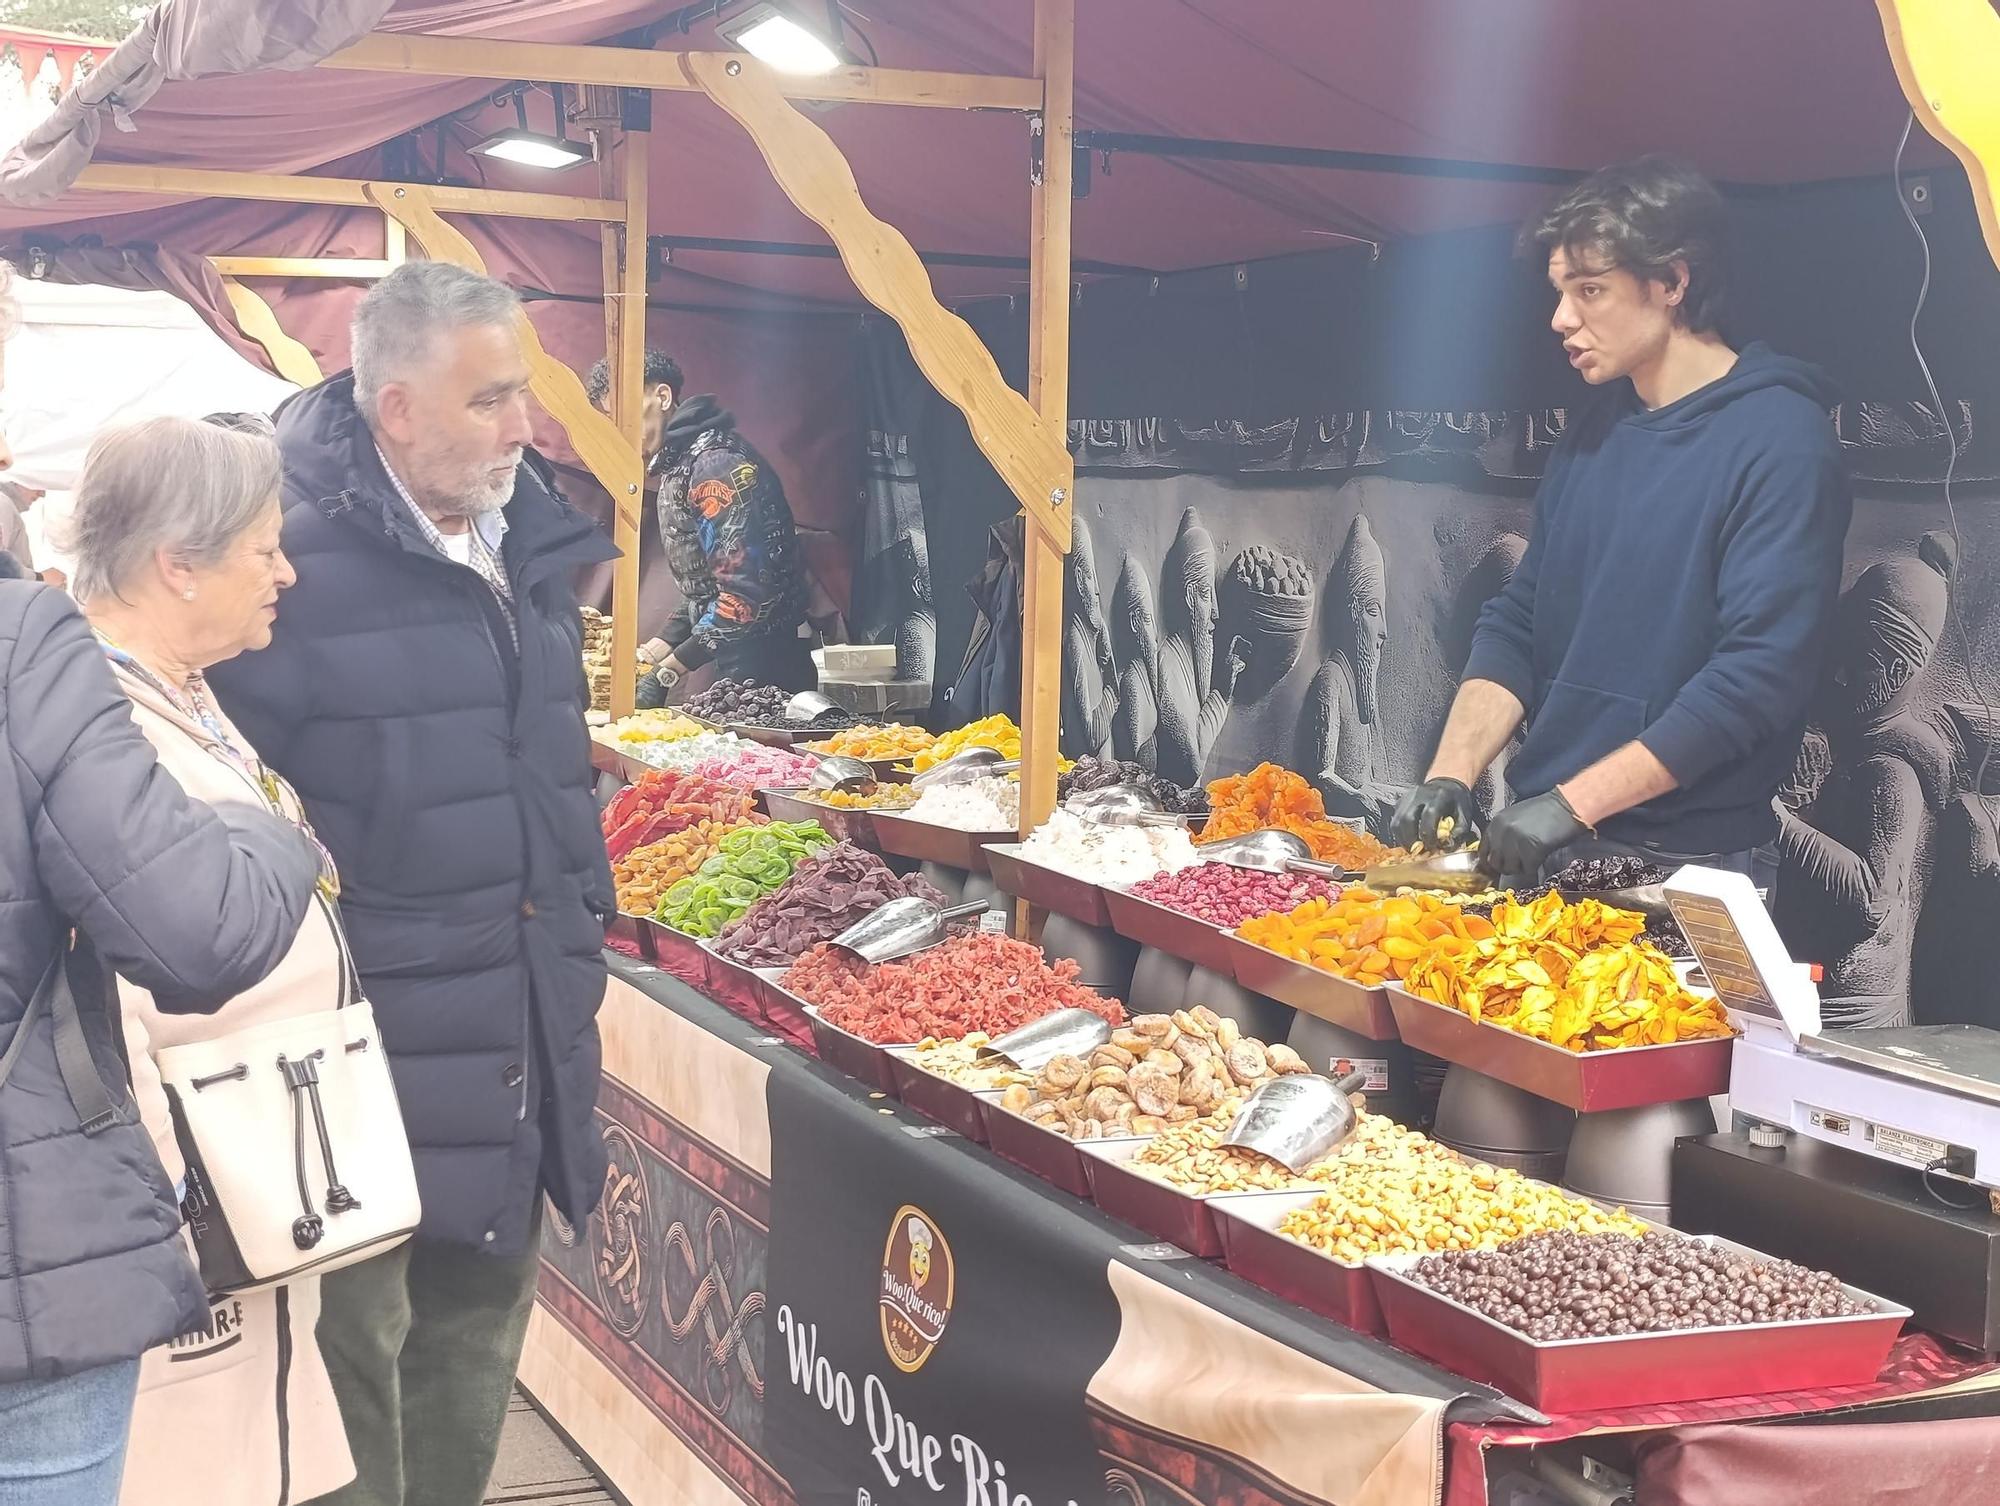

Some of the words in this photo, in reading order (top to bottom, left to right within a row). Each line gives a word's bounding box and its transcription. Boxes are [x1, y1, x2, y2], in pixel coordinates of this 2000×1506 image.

[1880, 1127, 1902, 1139] BALANZA
[777, 1304, 856, 1426] Woo
[864, 1374, 946, 1491] Que
